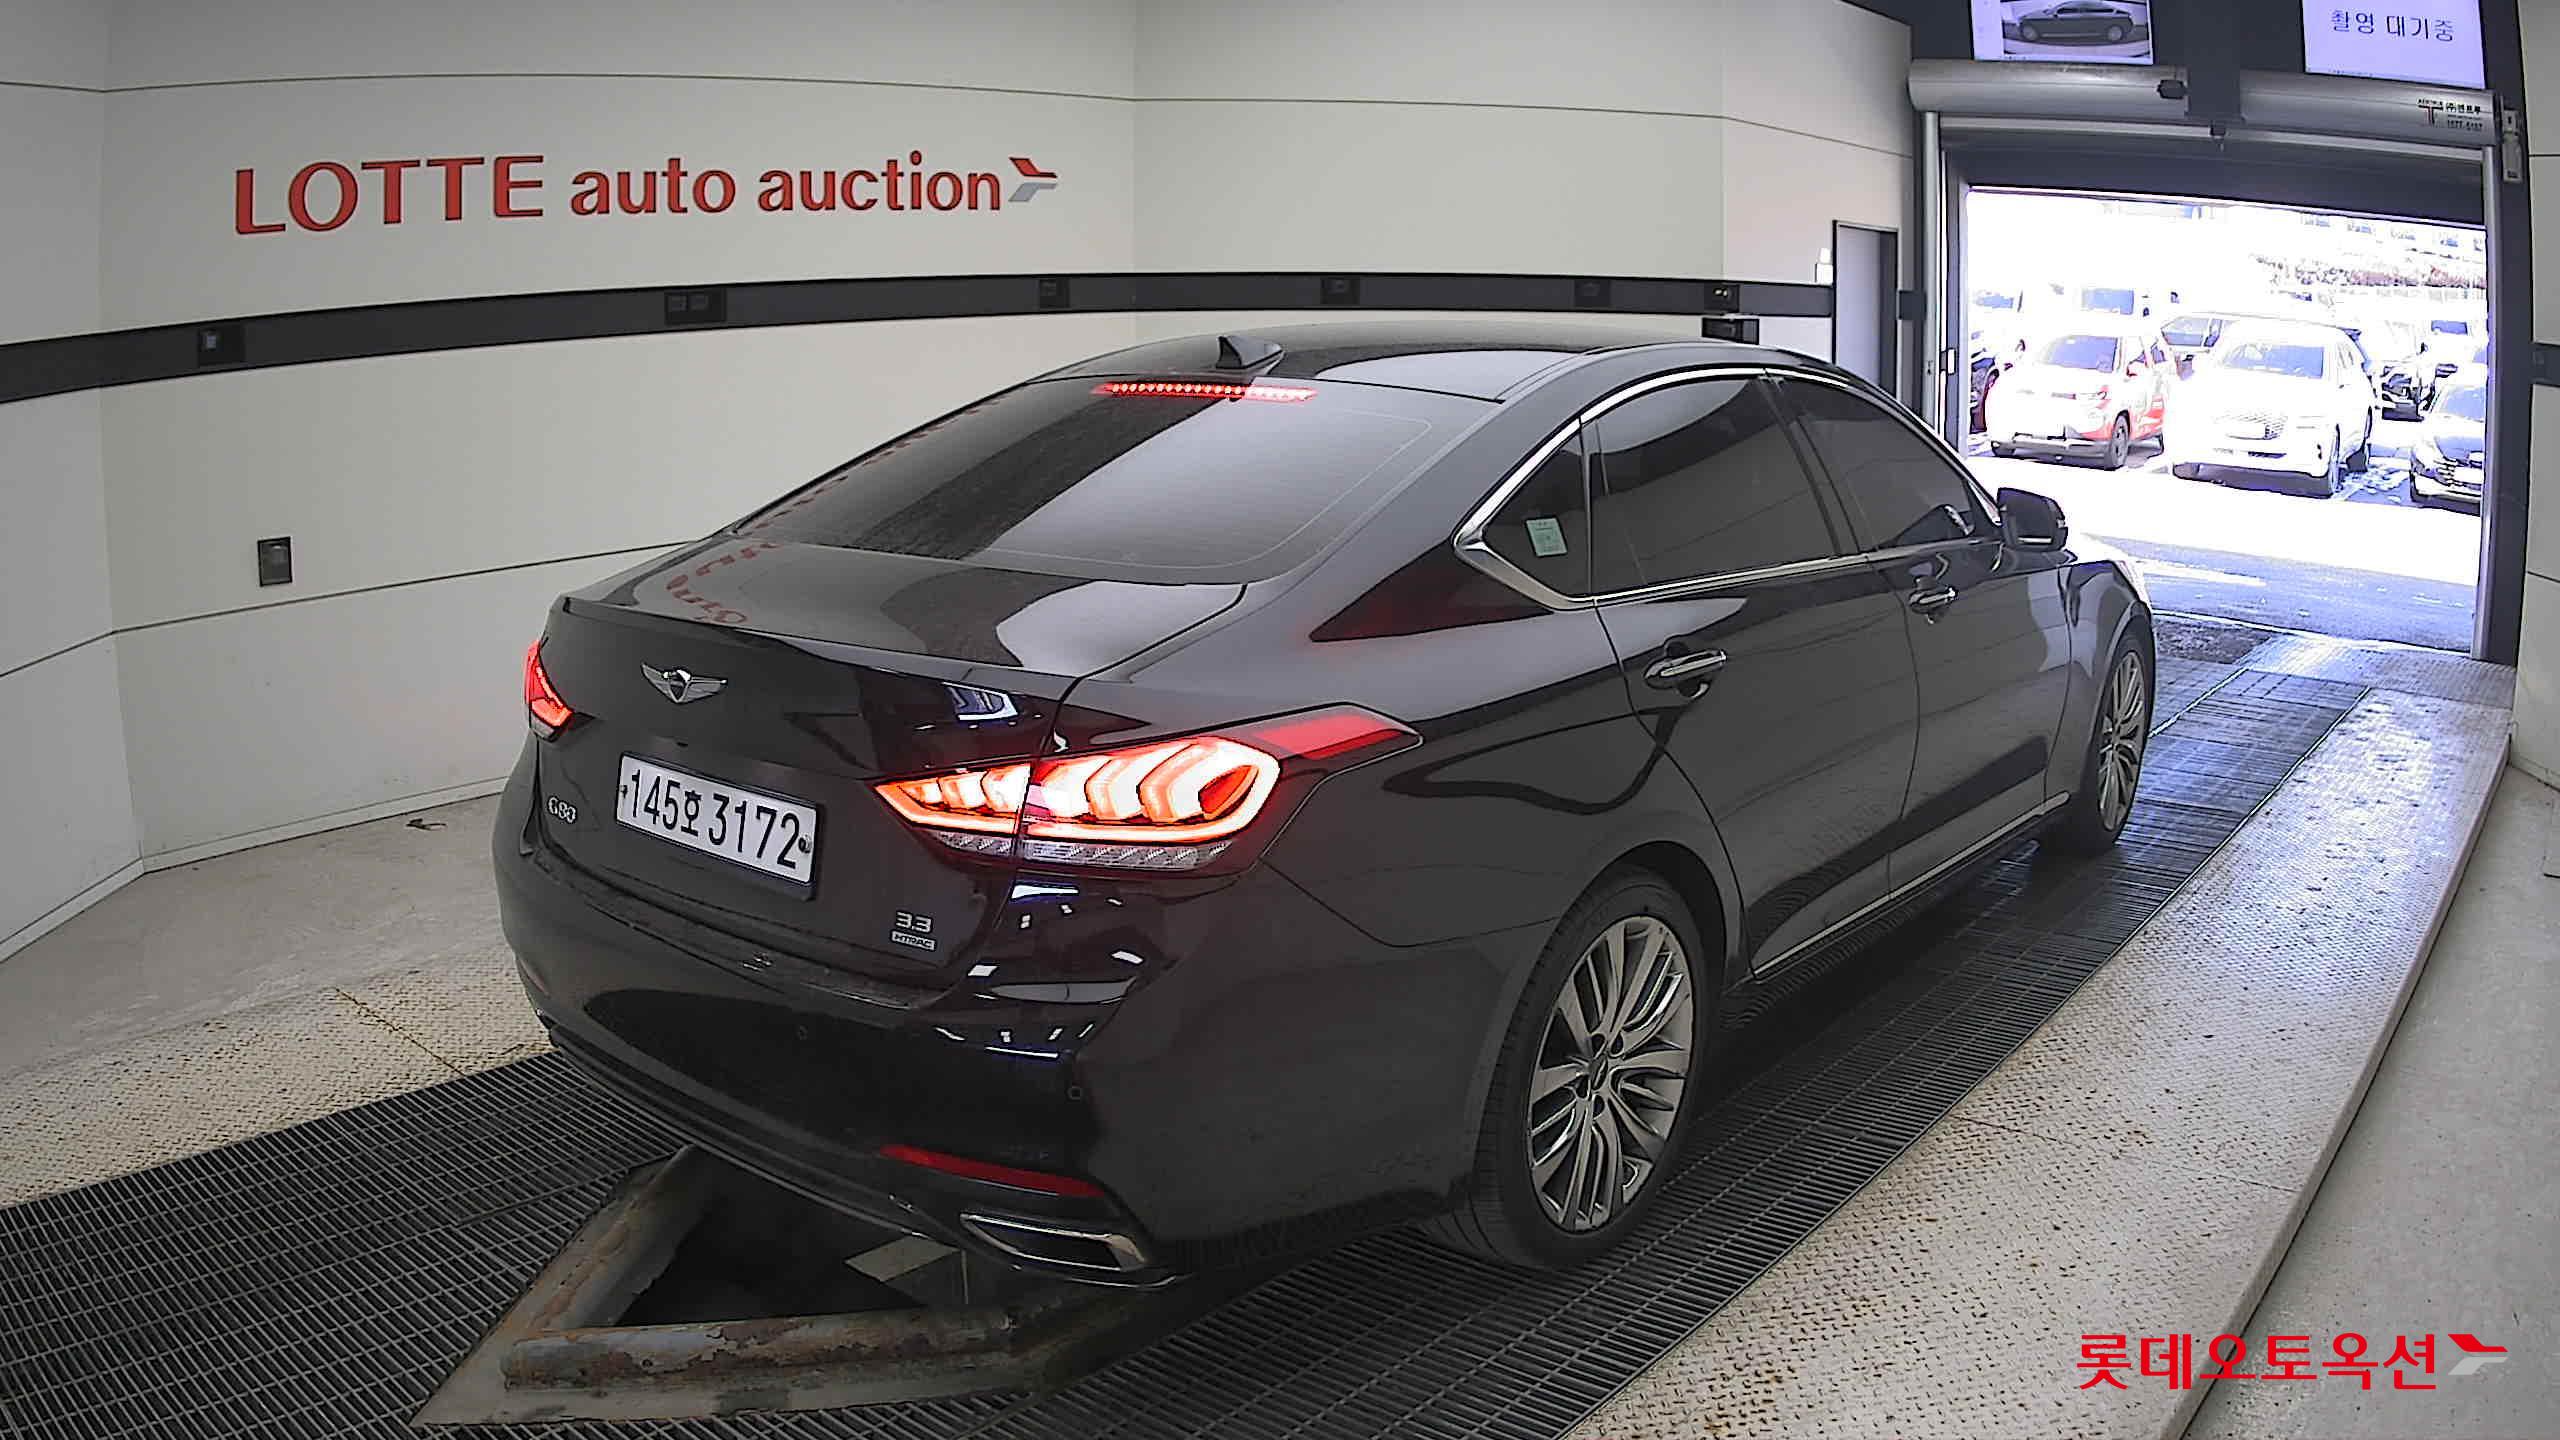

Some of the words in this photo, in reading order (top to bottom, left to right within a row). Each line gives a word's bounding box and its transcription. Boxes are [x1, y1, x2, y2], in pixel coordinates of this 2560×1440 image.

[2332, 10, 2375, 34] 촬영
[2386, 16, 2454, 42] 대기중
[235, 155, 544, 235] LOTTE
[570, 157, 736, 215] auto
[757, 150, 1001, 212] auction
[632, 769, 701, 836] 145호
[708, 794, 800, 868] 3172
[896, 912, 932, 933] 3.3
